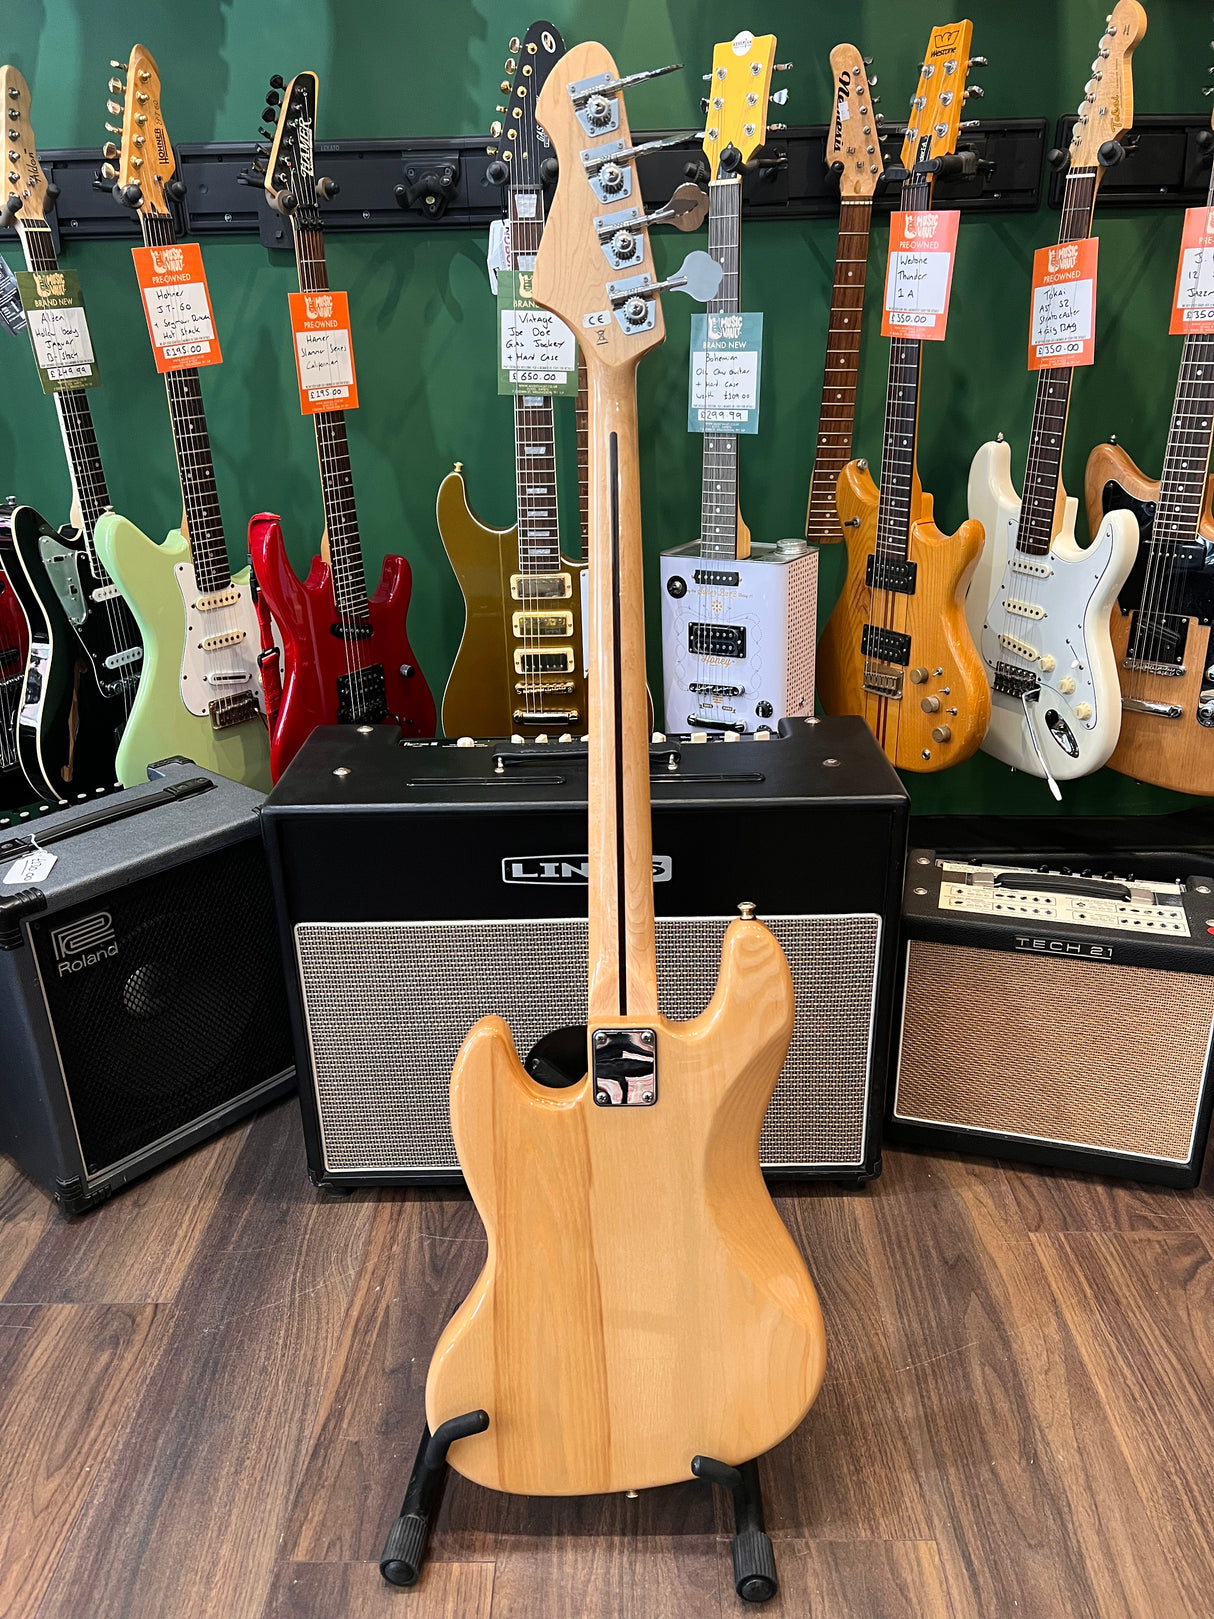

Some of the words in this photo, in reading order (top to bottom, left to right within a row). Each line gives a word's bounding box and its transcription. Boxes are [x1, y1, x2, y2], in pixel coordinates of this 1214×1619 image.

[931, 47, 957, 58] Westone
[1111, 94, 1122, 132] Tokai
[154, 128, 169, 165] HOHNER
[298, 117, 314, 177] HAMER
[917, 213, 939, 227] MUSIC
[917, 226, 937, 239] VAULT
[899, 241, 939, 249] PRE-OWNED
[1058, 245, 1078, 259] MUSIC
[900, 255, 928, 265] Westone
[1059, 256, 1077, 269] VAULT
[152, 273, 191, 284] PRE-OWNED
[897, 269, 927, 281] Thunder
[1043, 271, 1081, 284] PRE-OWNED
[1188, 271, 1199, 279] 12
[156, 290, 184, 300] Hohner
[34, 299, 58, 307] BRAND
[304, 320, 338, 329] PRE-OWNED
[588, 314, 604, 325] CE
[720, 315, 743, 328] MUSIC
[891, 314, 927, 324] £350.00
[163, 331, 176, 340] Hot
[181, 328, 200, 337] Stack
[508, 327, 523, 336] Joe
[532, 327, 551, 336] Doe
[722, 326, 742, 339] VAULT
[45, 339, 74, 350] Jaguar
[306, 335, 330, 344] Hamer
[533, 339, 565, 349] Jockey
[703, 341, 727, 349] BRAND
[728, 341, 747, 349] NEW
[165, 345, 202, 357] £195.00
[329, 344, 347, 353] Series
[1038, 343, 1080, 355] £350.00
[706, 353, 738, 363] Bohemian
[310, 387, 342, 399] £195.00
[701, 411, 742, 420] £299.99
[701, 654, 732, 668] Honey
[1015, 937, 1081, 953] TECH
[1090, 946, 1113, 957] 21
[58, 941, 119, 977] Roland
